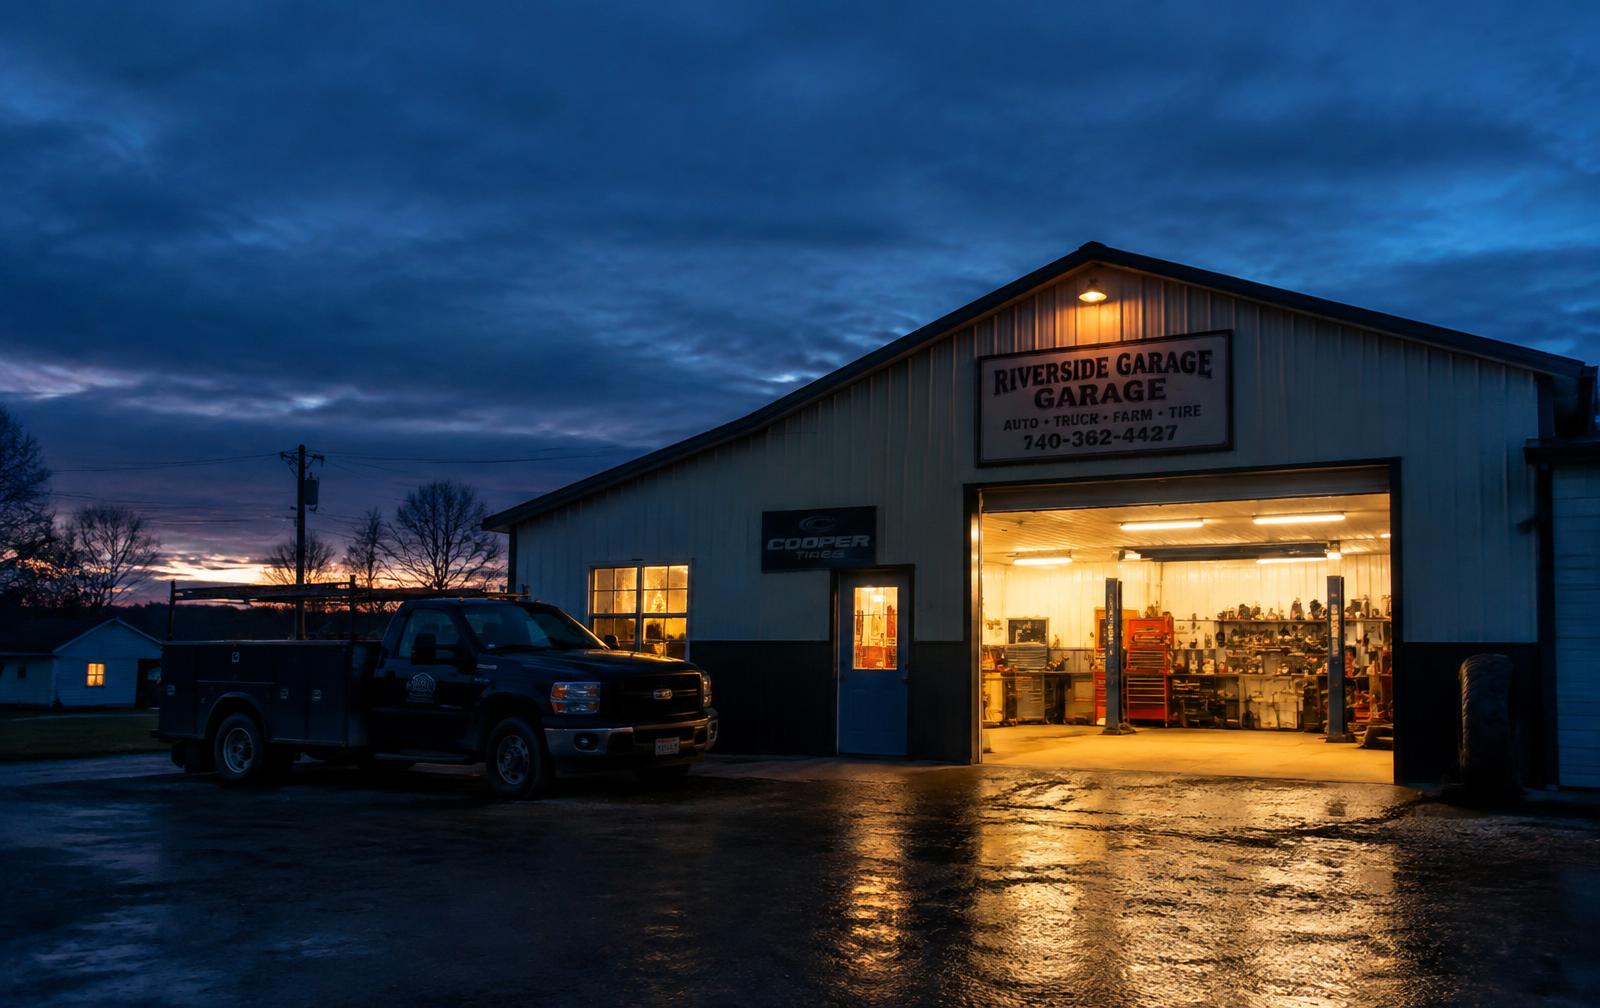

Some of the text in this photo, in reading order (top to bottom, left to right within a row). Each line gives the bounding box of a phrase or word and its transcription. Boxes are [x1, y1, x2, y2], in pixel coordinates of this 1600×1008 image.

[993, 350, 1213, 397] RIVERSIDE GARAGE
[1034, 378, 1167, 409] GARAGE
[1003, 405, 1201, 431] AUTO TRUCK FARM TIRE
[1023, 425, 1179, 451] 740-362-4427
[767, 534, 871, 551] COOPER
